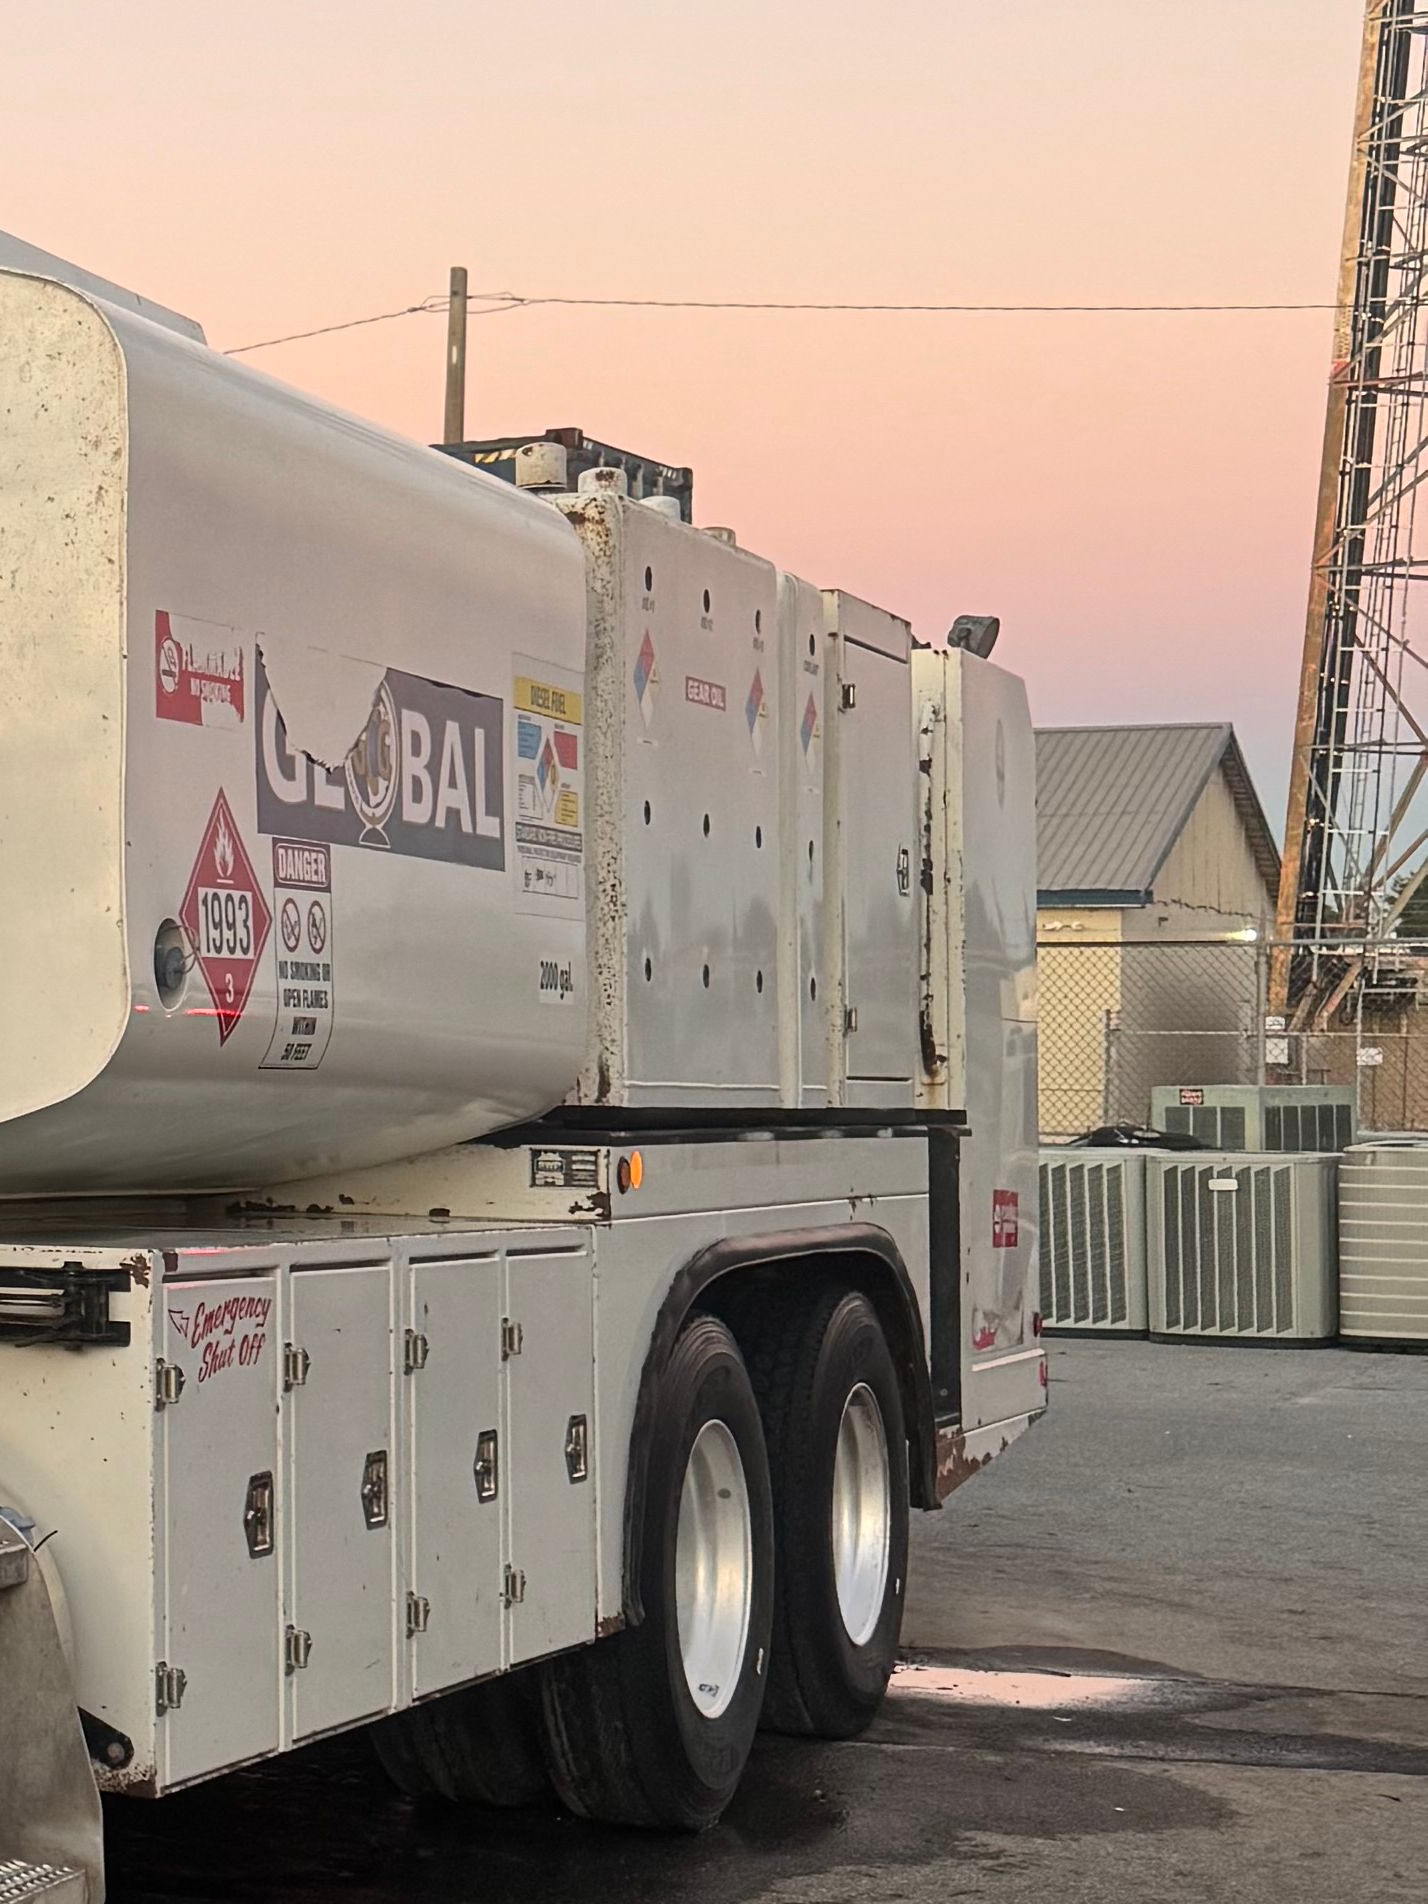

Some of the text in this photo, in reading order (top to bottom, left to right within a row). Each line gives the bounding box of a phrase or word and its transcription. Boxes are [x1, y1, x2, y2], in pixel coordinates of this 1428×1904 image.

[688, 679, 725, 709] GEAR OIL
[277, 847, 326, 883] DANGER
[201, 891, 251, 956] 1993
[224, 972, 235, 1004] 3
[540, 960, 559, 992] 2000
[191, 1296, 272, 1349] Emergency
[198, 1333, 266, 1383] Shut Off
